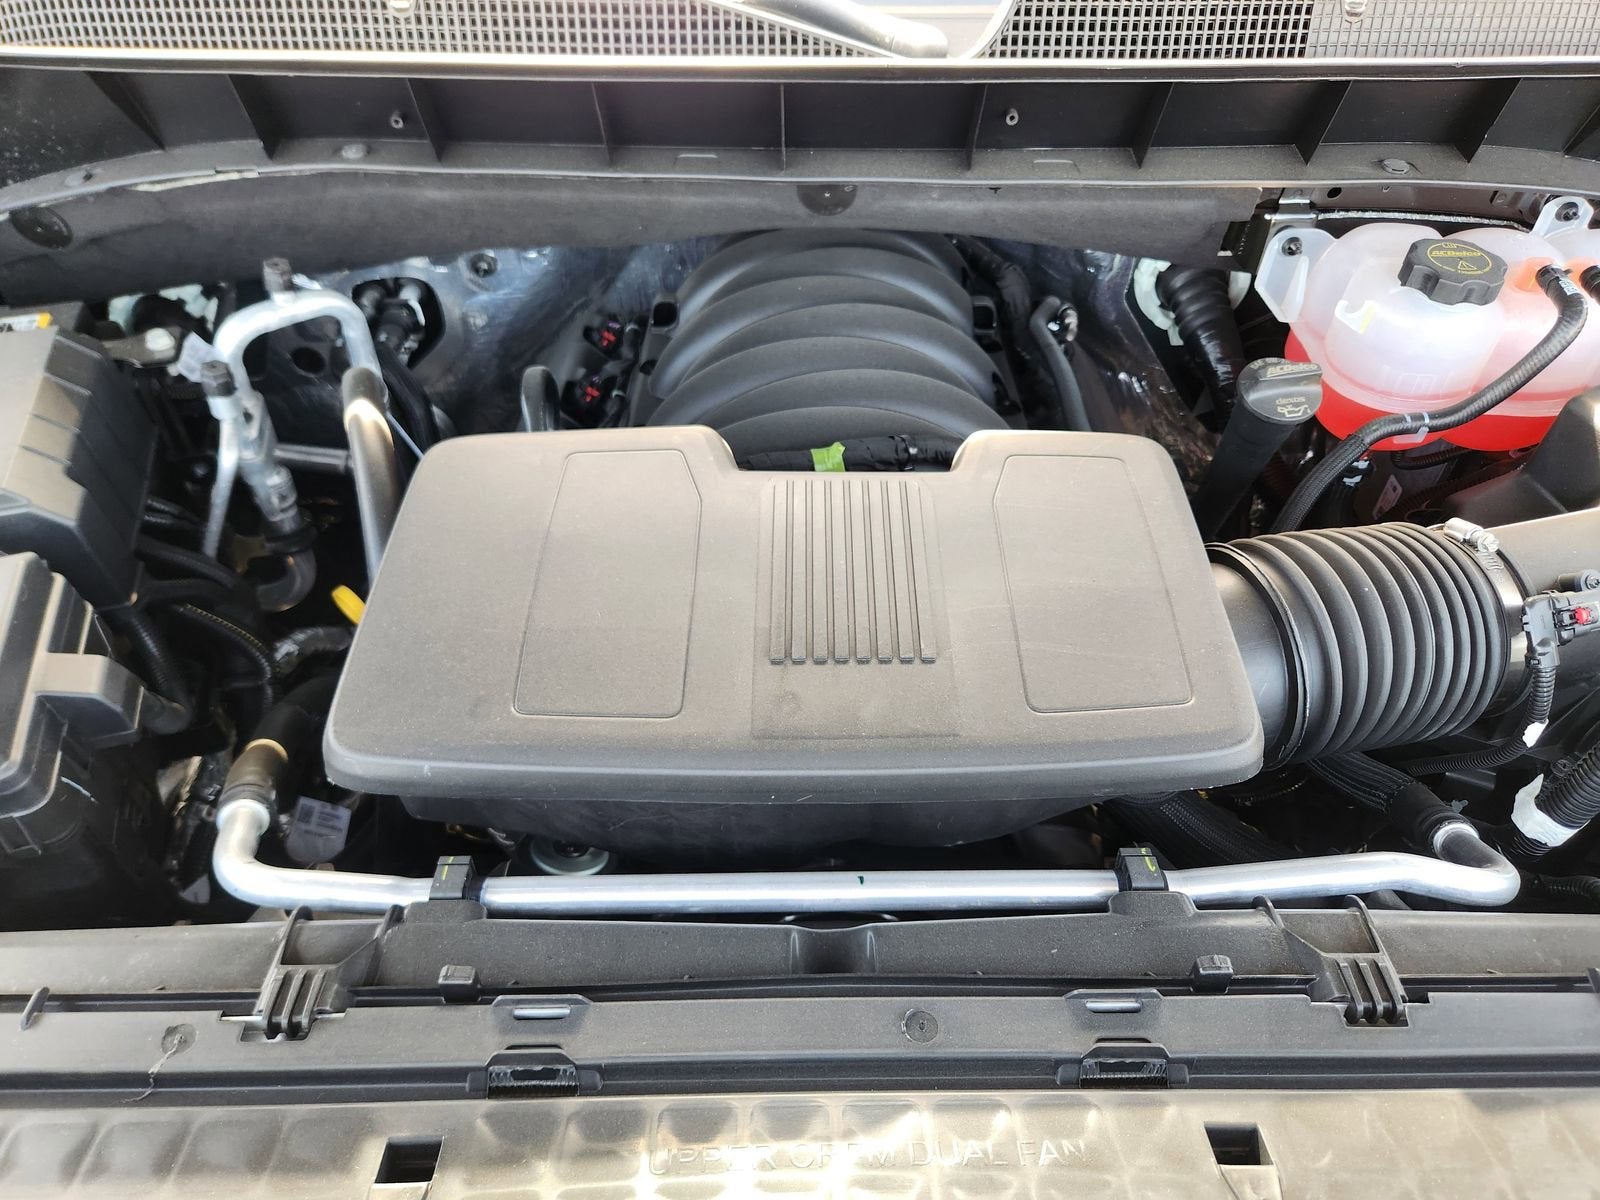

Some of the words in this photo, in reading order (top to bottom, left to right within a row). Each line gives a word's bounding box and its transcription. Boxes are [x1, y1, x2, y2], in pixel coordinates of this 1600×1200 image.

[1267, 363, 1318, 376] ACDelco
[909, 1140, 1009, 1167] DUAL
[1017, 1139, 1087, 1166] FAN
